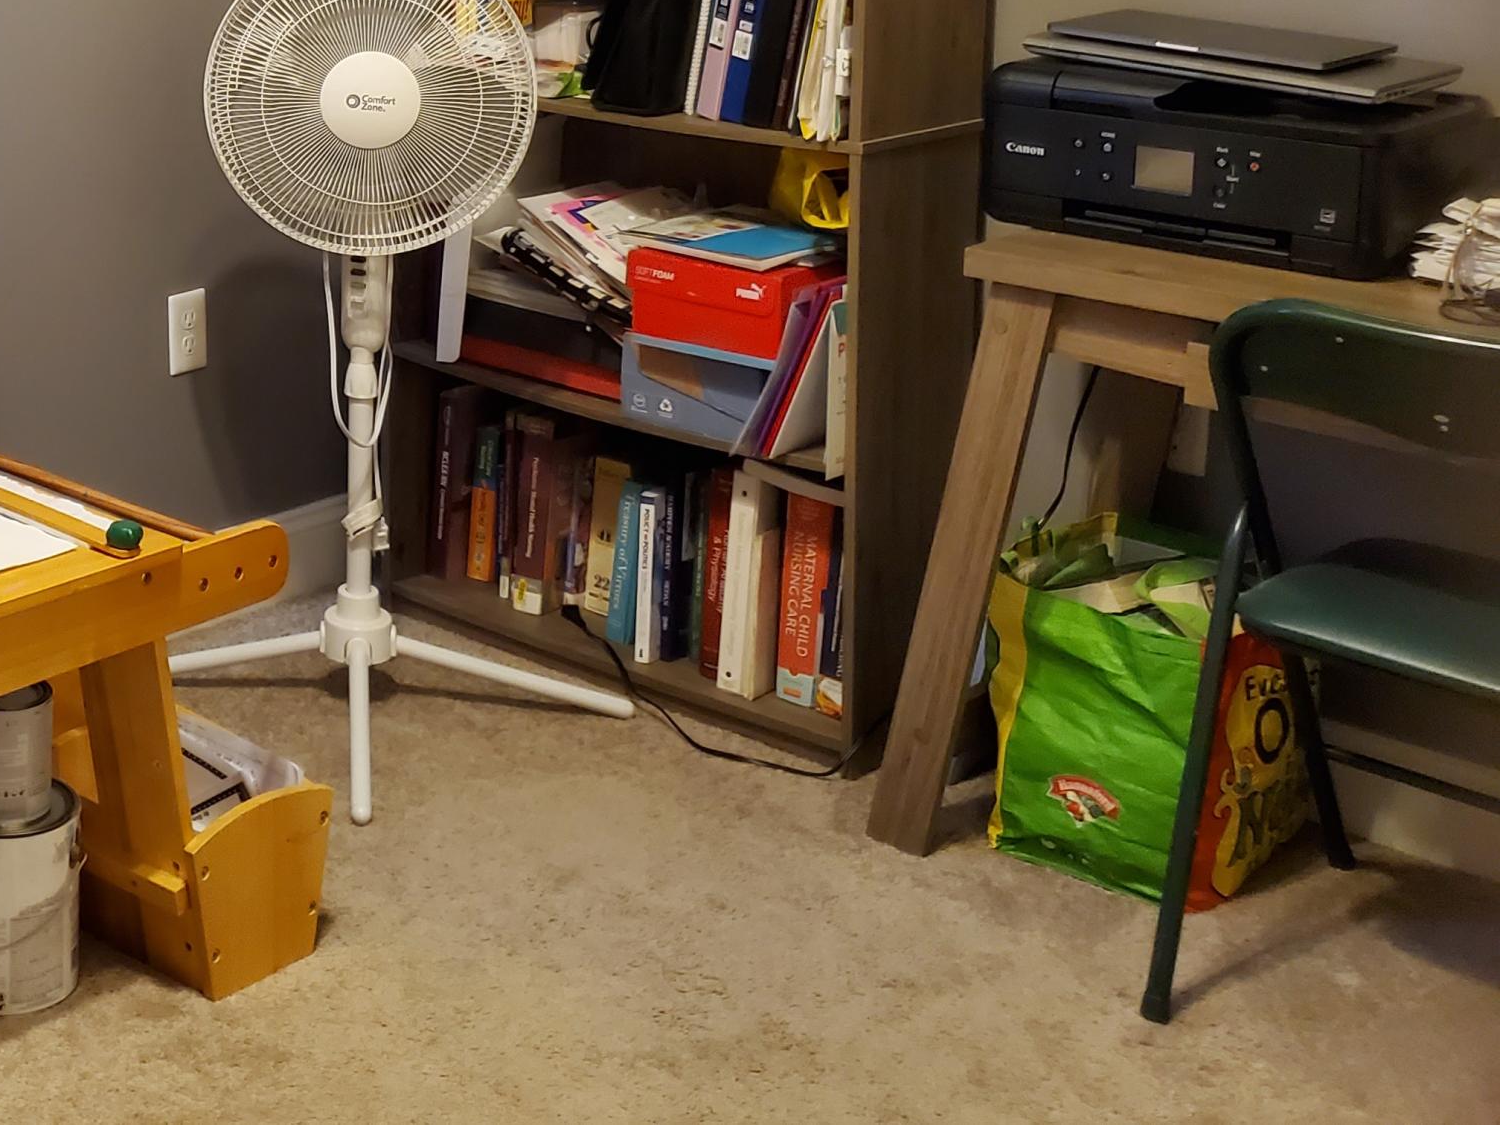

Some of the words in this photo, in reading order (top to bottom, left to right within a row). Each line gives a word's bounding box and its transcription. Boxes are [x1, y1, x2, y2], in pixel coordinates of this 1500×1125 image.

[361, 94, 396, 105] Comfort
[1006, 141, 1045, 156] Canon
[620, 494, 636, 544] Treasury
[707, 547, 722, 602] Physiology
[789, 530, 804, 596] NURSING
[799, 535, 818, 610] MATERNAL
[785, 598, 799, 636] CARE
[795, 616, 812, 658] CHILD
